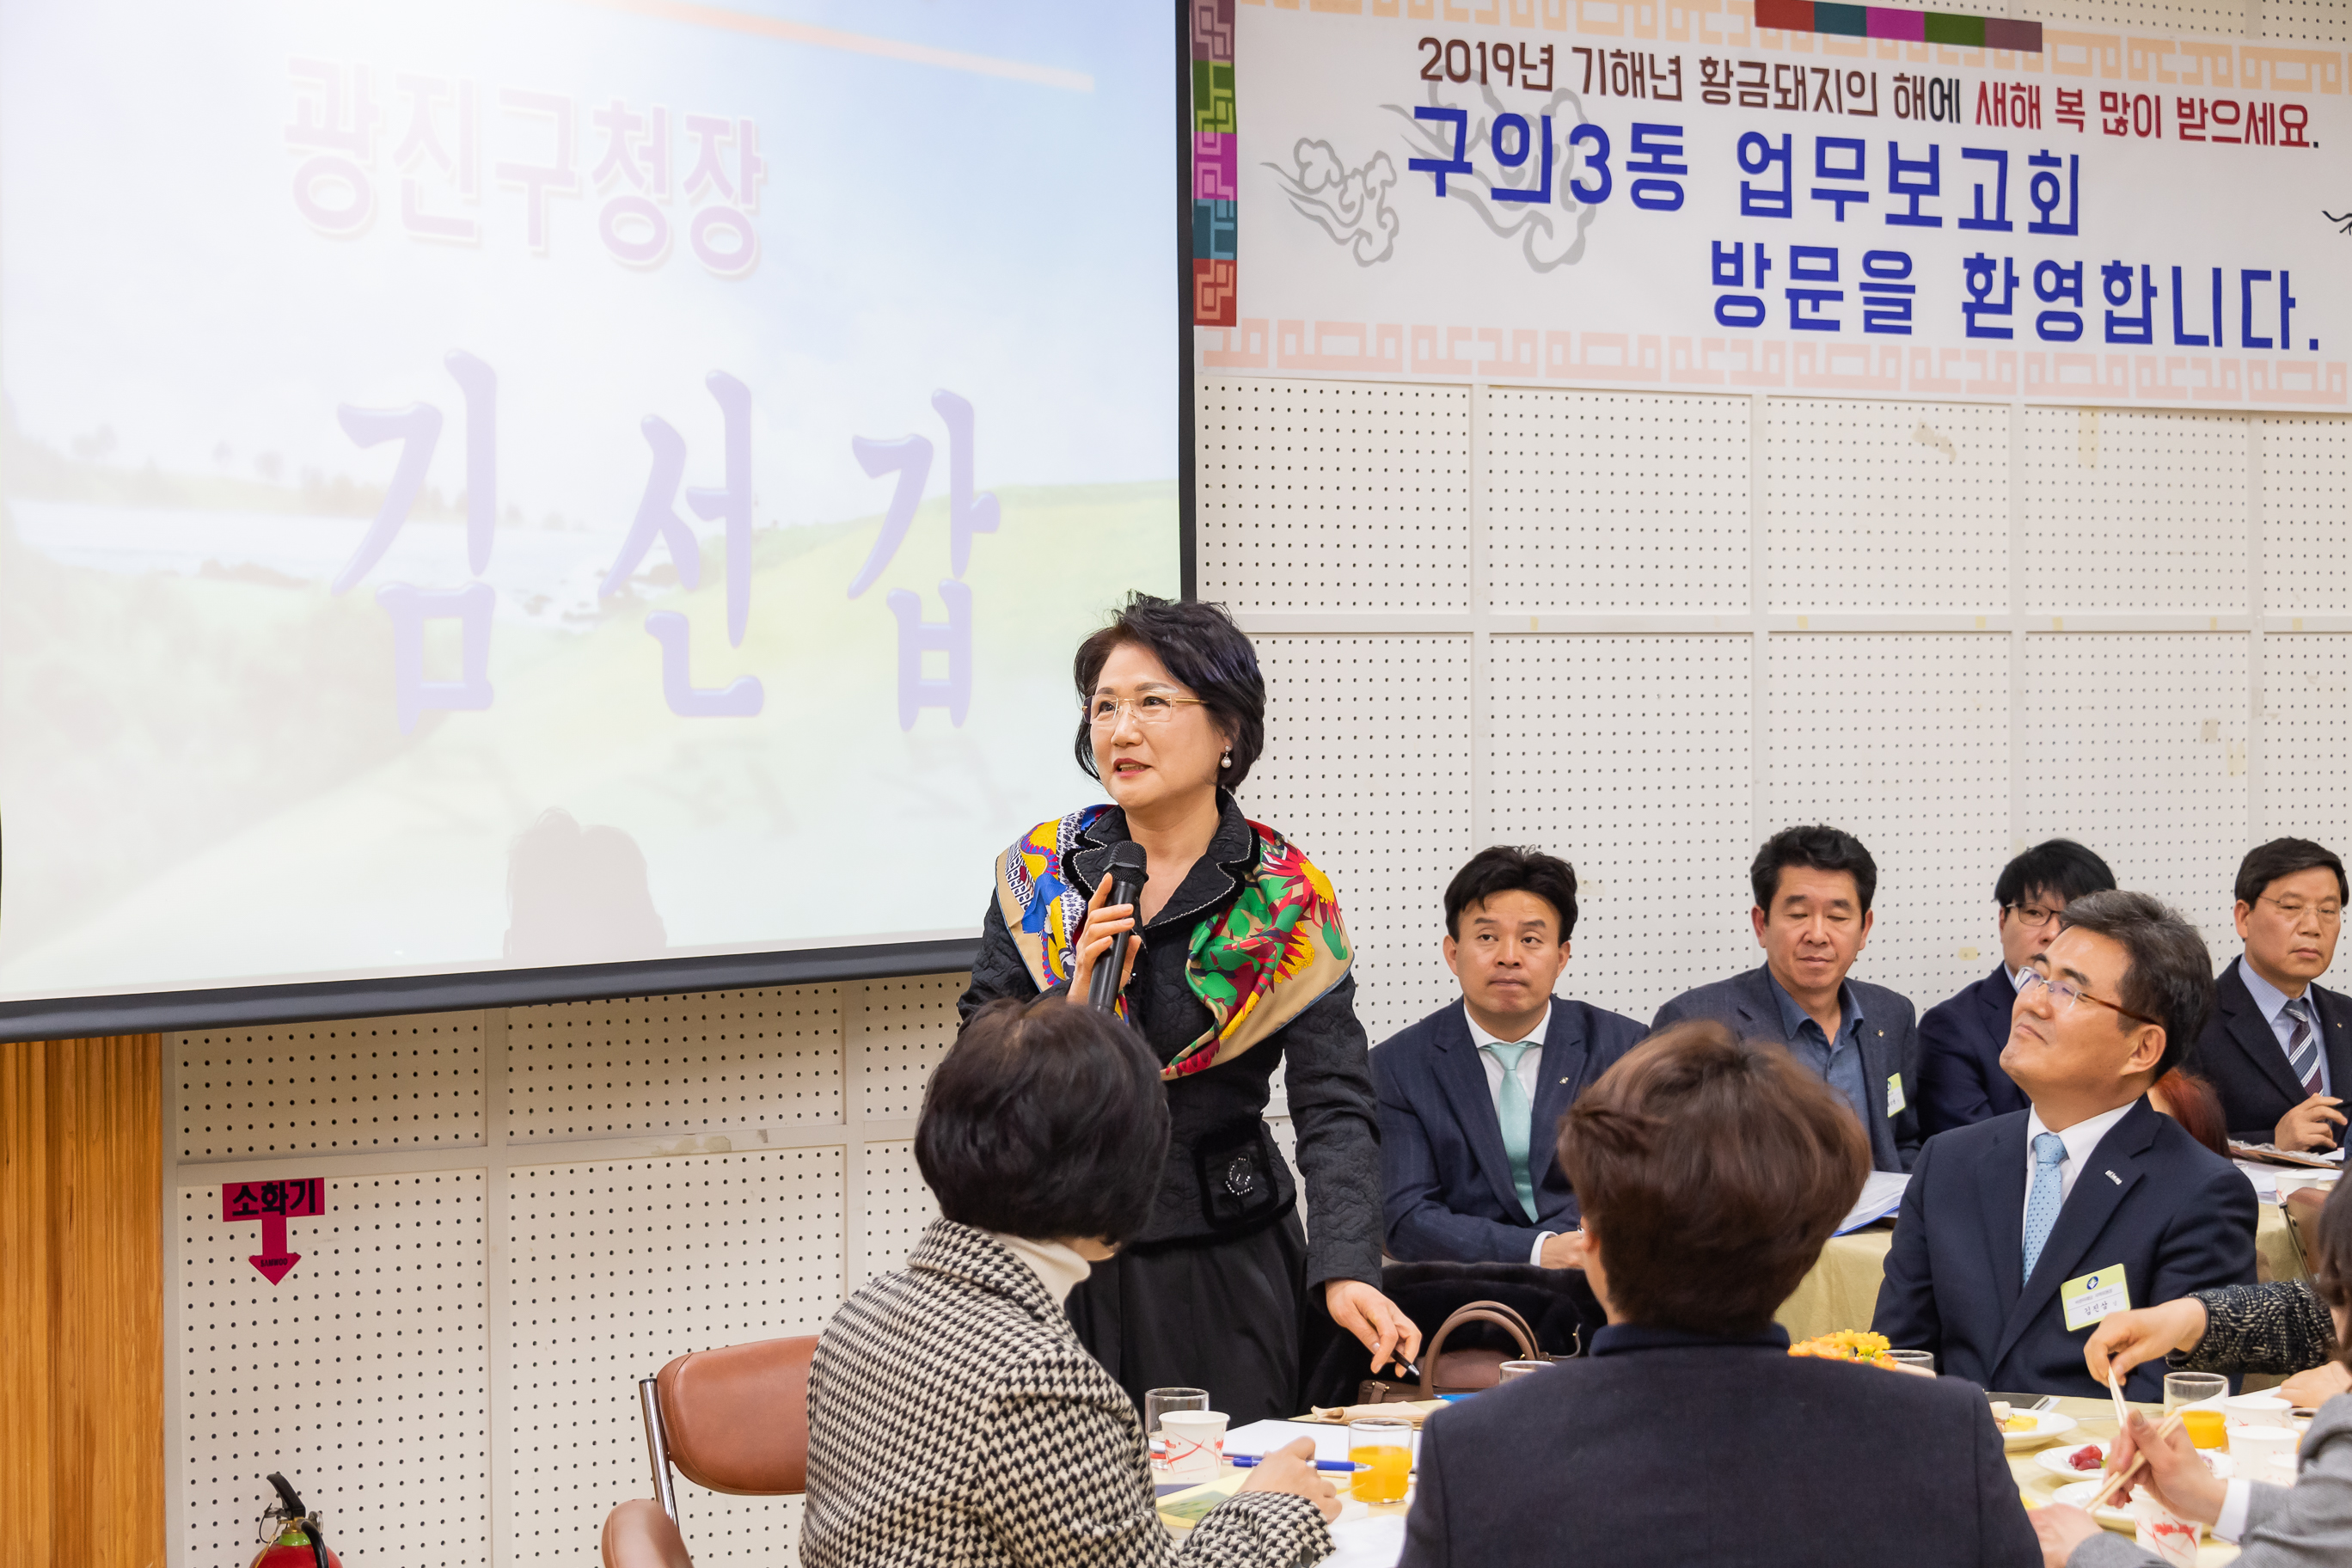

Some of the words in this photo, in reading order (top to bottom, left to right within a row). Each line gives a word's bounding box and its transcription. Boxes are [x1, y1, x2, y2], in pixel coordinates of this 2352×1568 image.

[1418, 37, 1554, 92] 2019년
[1572, 47, 1683, 101] 기해년
[1700, 56, 1879, 117] 황금돼지의
[1894, 72, 1962, 124] 해에
[1975, 81, 2043, 130] 새해
[2055, 88, 2086, 133] 복
[2100, 90, 2163, 138] 많이
[2177, 96, 2320, 149] 받으세요.
[284, 55, 767, 275] 광진구청장
[1408, 106, 1688, 212] 구의3동
[1736, 131, 2079, 236] 업무보고회
[1712, 241, 1917, 335] 방문을
[1963, 253, 2319, 351] 환영합니다.
[232, 1179, 315, 1216] 소화기
[260, 1258, 288, 1268] SAMWOO
